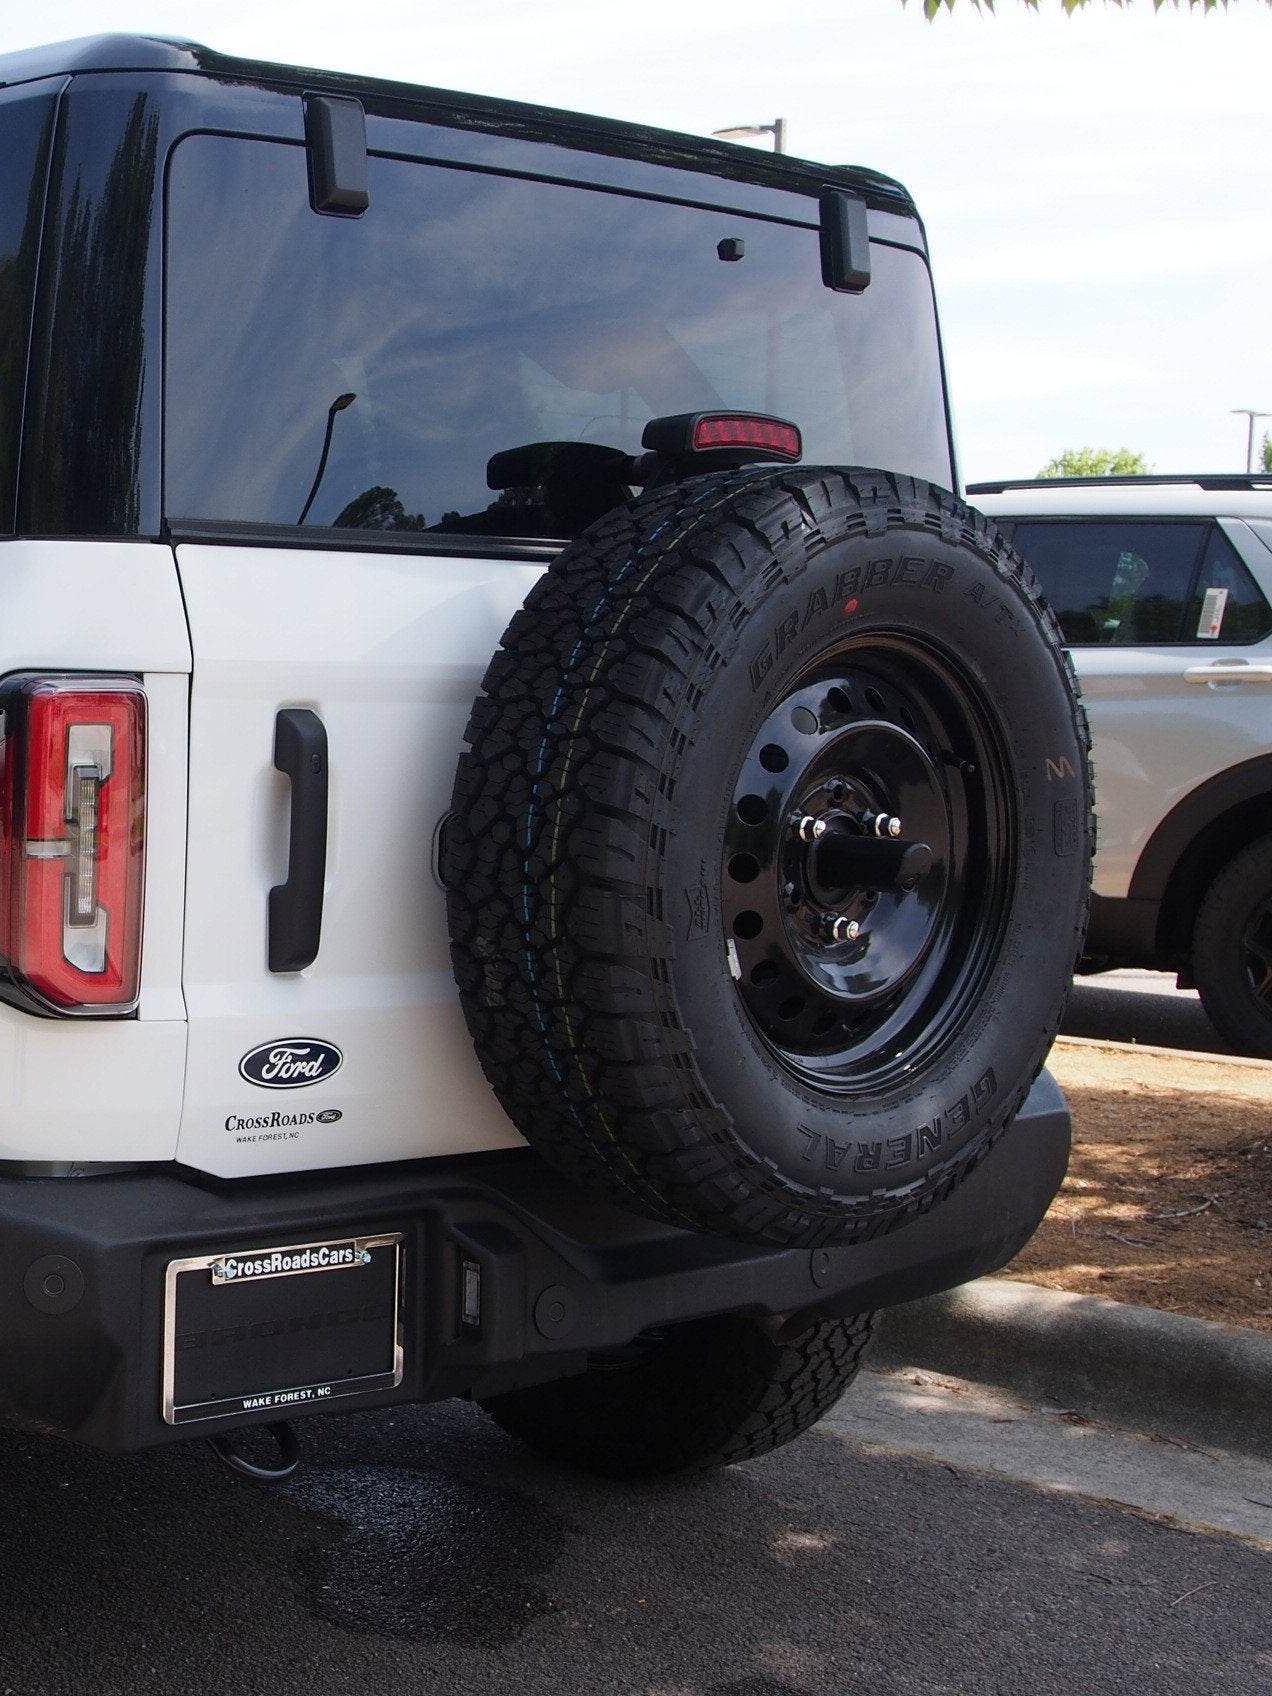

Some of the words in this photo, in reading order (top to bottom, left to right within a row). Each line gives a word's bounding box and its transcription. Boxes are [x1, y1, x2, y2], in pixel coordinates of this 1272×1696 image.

[747, 555, 956, 693] GRABBER
[261, 1046, 326, 1080] Ford
[796, 1065, 999, 1175] GENERAL
[236, 1135, 257, 1143] WAKE
[289, 1131, 300, 1139] NC
[225, 1246, 354, 1277] CrossRoadsCars
[242, 1396, 272, 1409] WAKE
[274, 1389, 316, 1404] FOREST,
[317, 1386, 332, 1397] NC
